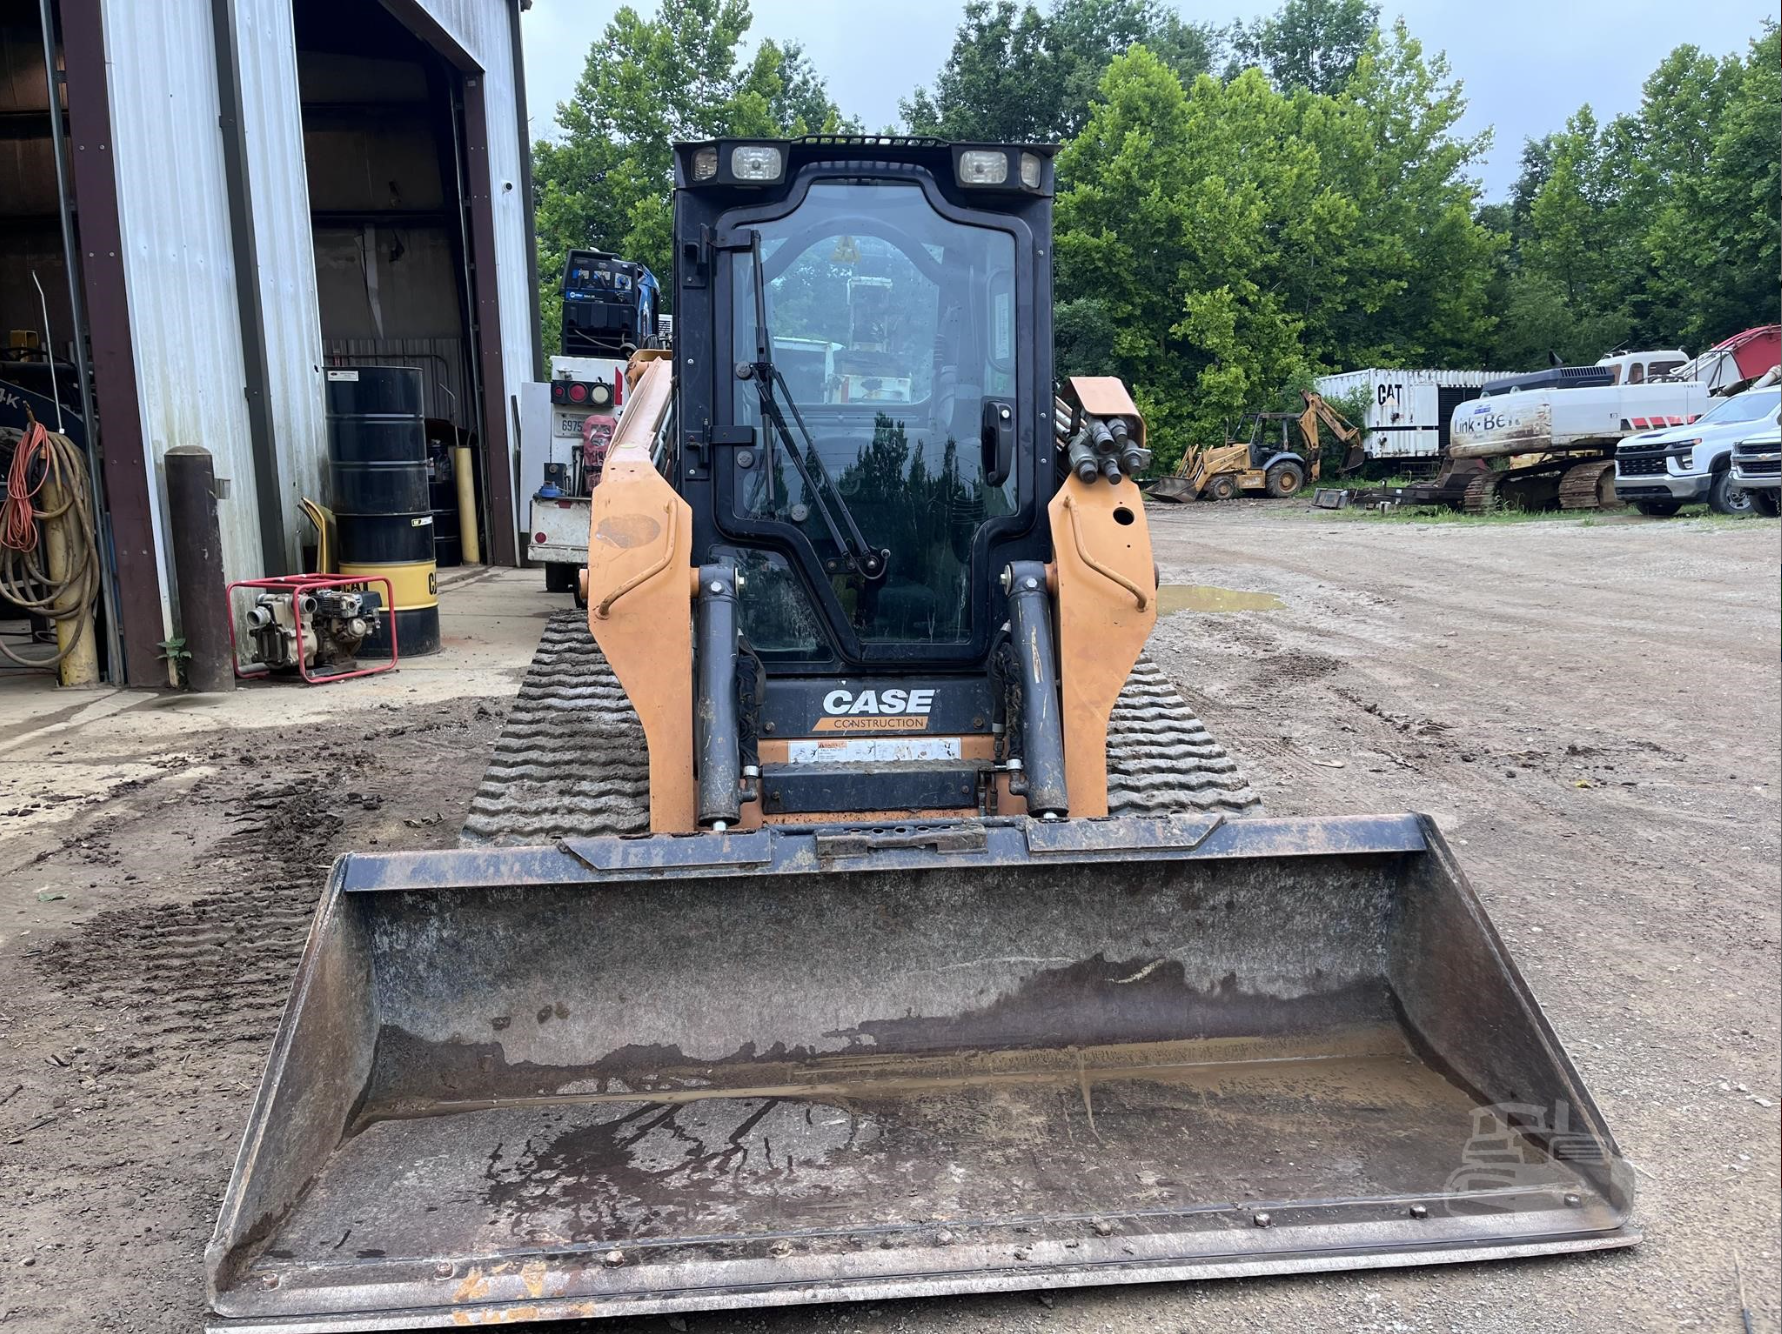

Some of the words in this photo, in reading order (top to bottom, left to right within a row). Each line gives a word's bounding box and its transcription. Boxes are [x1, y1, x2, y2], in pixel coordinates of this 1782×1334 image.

[1378, 384, 1402, 406] CAT
[823, 689, 936, 715] CASE
[834, 718, 924, 729] CONSTRUCTION
